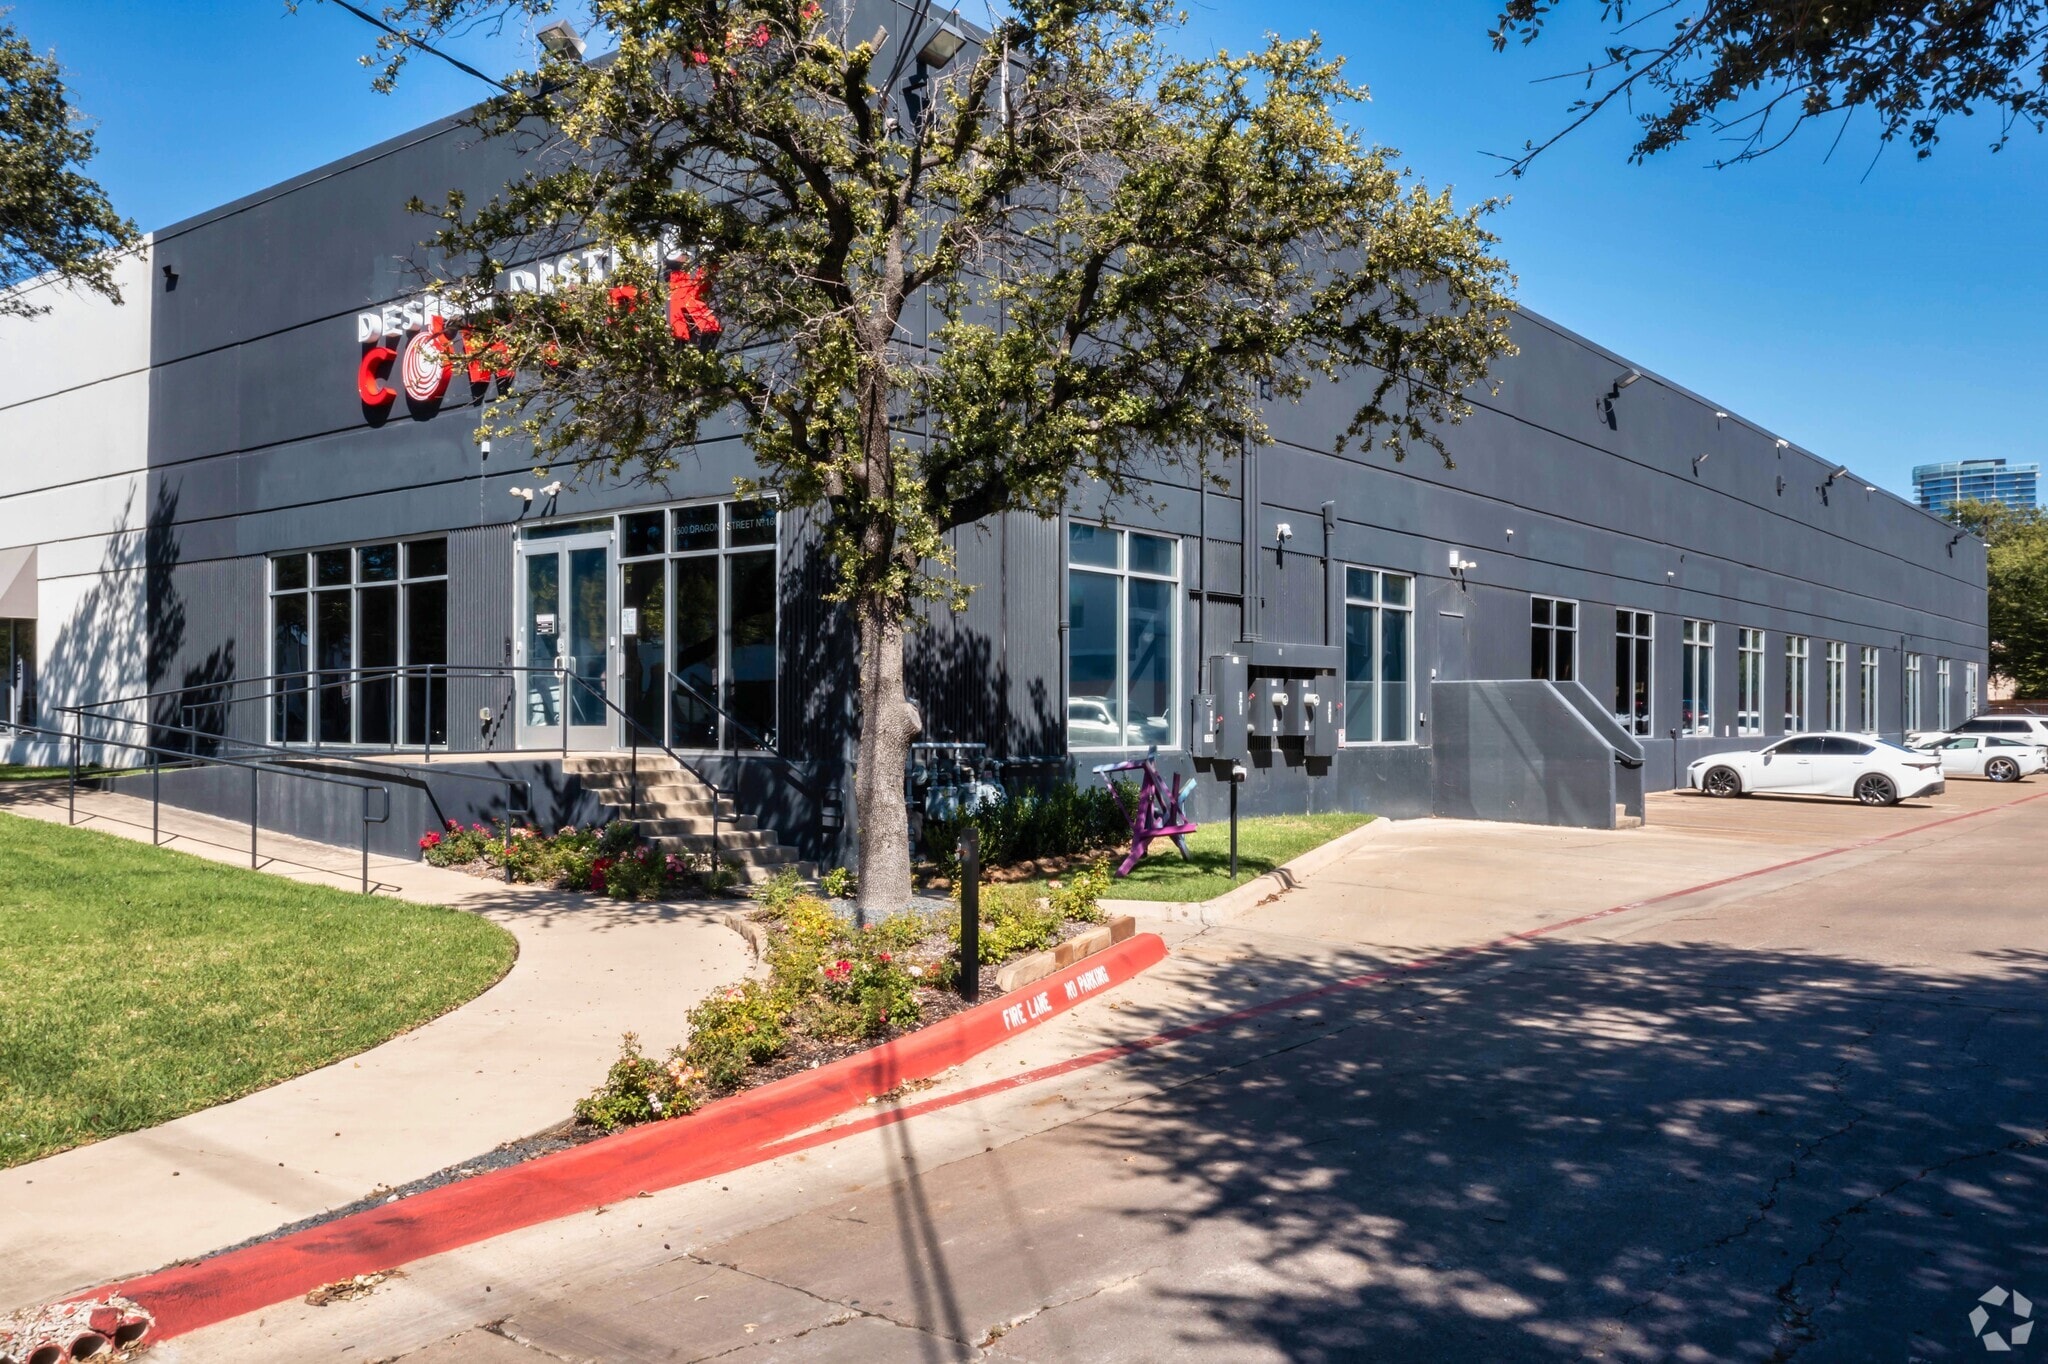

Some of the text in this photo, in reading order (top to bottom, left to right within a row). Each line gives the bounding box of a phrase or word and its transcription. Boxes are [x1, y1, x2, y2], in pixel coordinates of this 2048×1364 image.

[689, 523, 719, 534] DRAGON
[726, 519, 755, 530] STREET
[766, 517, 777, 526] 16
[1002, 965, 1110, 1031] FIRE LANE NO PARKING
